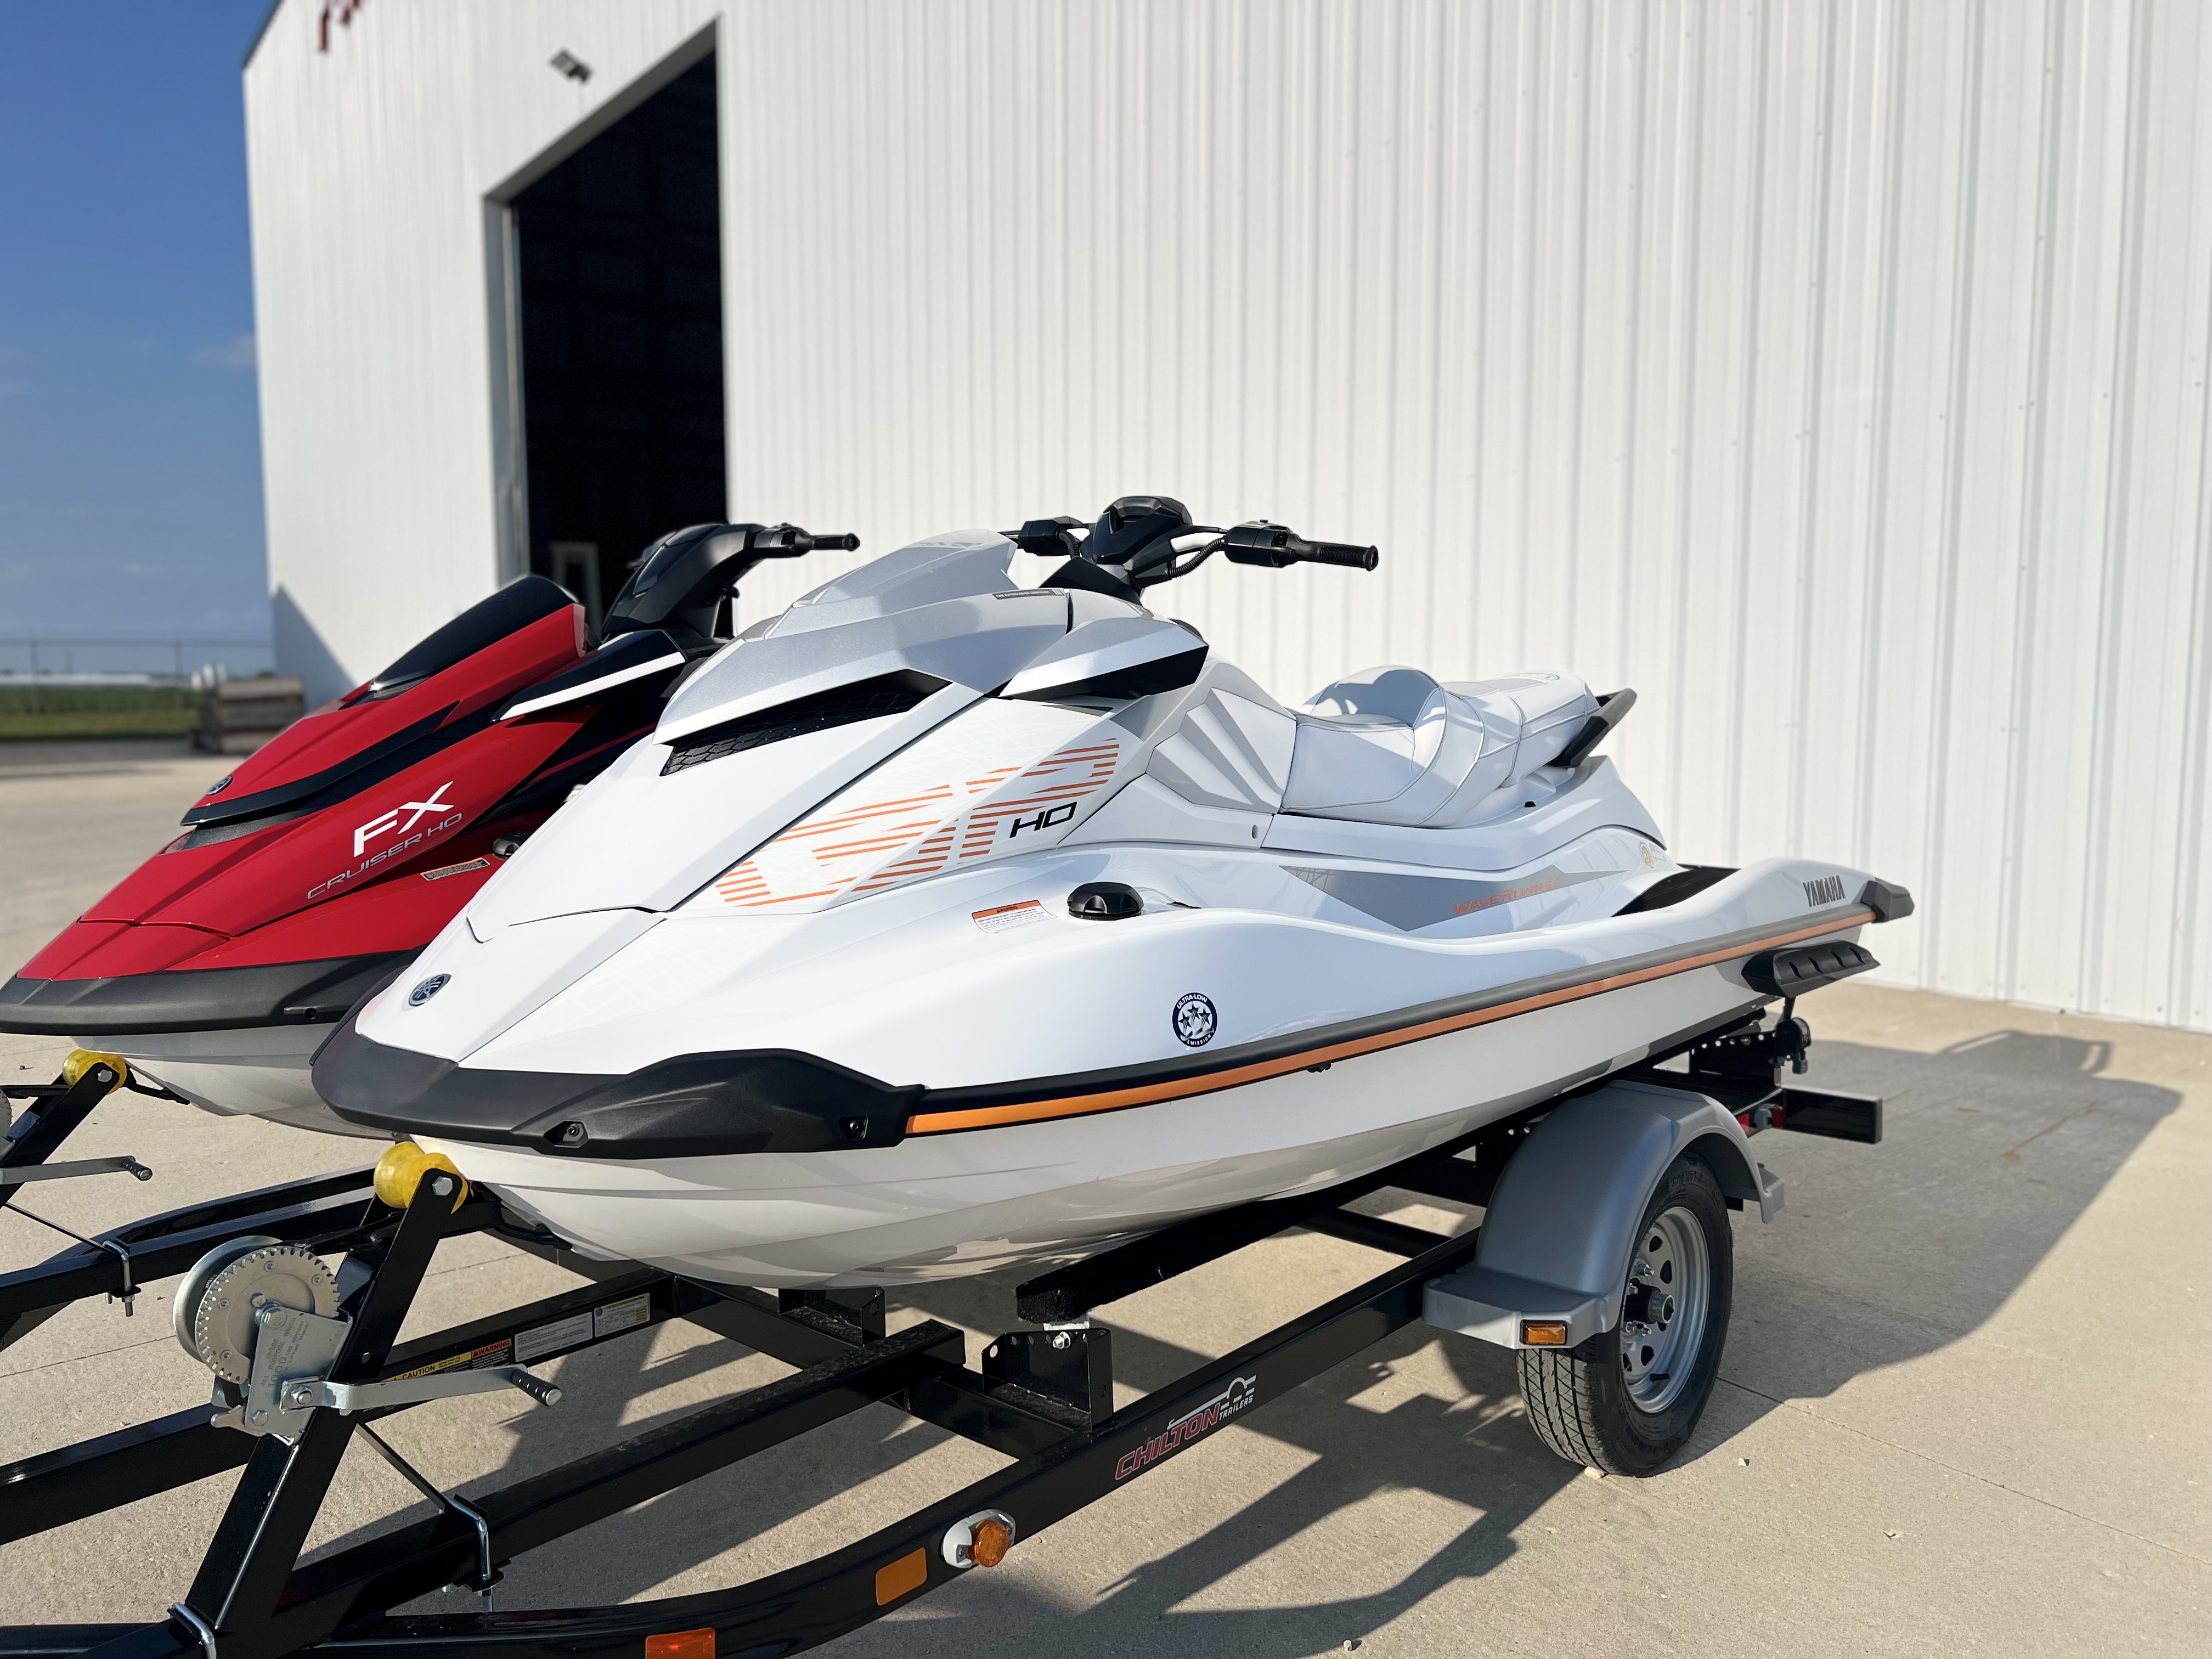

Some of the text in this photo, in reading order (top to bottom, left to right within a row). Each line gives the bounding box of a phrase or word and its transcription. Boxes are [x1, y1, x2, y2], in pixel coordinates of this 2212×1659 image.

[354, 781, 454, 857] FX
[307, 832, 422, 900] CRUISER
[1803, 875, 1846, 907] YAMAHA
[1187, 1033, 1211, 1046] EMISSION
[268, 1341, 285, 1370] PURPOSE
[283, 1317, 297, 1338] WINCH
[479, 1340, 511, 1356] WARNING
[267, 1356, 287, 1387] 1000
[402, 1364, 436, 1379] CAUTION
[1219, 1395, 1254, 1420] TRAILERS
[1115, 1402, 1221, 1480] CHILTON
